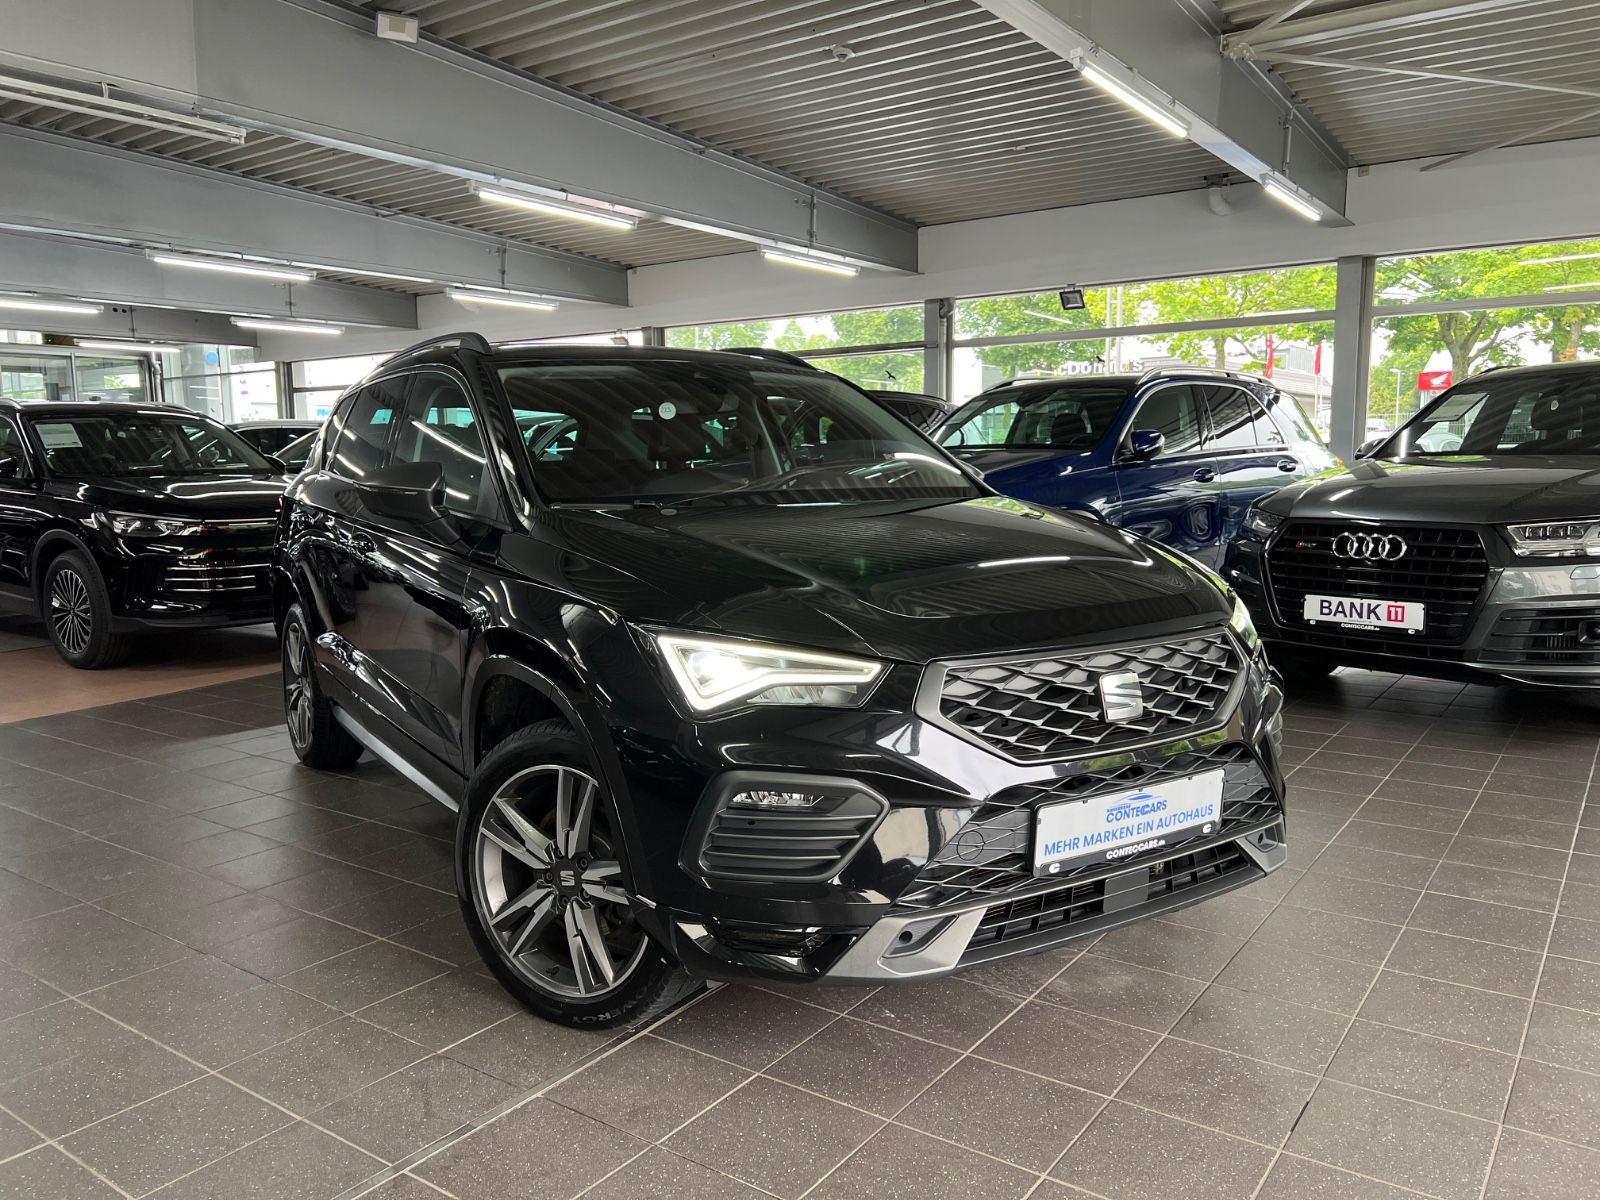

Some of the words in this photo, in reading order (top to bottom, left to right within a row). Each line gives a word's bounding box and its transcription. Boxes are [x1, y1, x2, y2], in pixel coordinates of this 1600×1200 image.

[1319, 599, 1382, 621] BANK
[1388, 606, 1404, 622] 11
[1044, 837, 1080, 856] MEHR
[1083, 824, 1134, 848] MARKEN
[1136, 819, 1154, 835] EIN
[1156, 804, 1214, 830] AUTOHAUS
[1106, 839, 1166, 860] CONTECCARS.de
